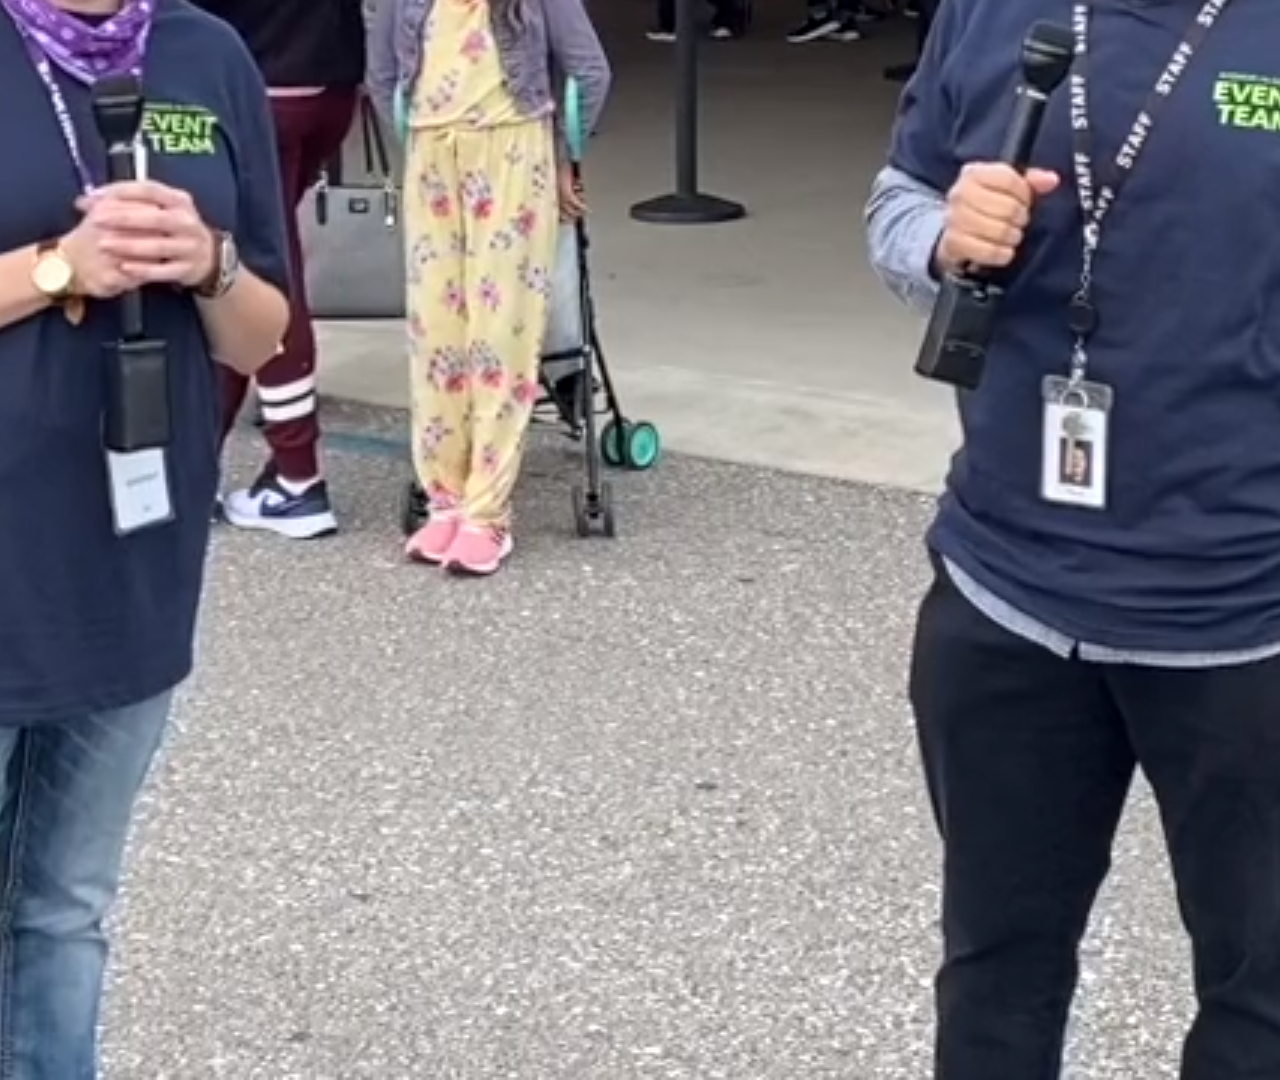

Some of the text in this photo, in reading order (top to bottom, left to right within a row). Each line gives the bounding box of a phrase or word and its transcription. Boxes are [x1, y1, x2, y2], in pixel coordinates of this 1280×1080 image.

[1155, 41, 1194, 96] STAFF
[141, 111, 218, 136] EVENT
[1070, 74, 1089, 131] STAFF
[147, 133, 215, 155] TEAM
[1115, 111, 1154, 170] STAFF
[1073, 151, 1095, 211] STAFF
